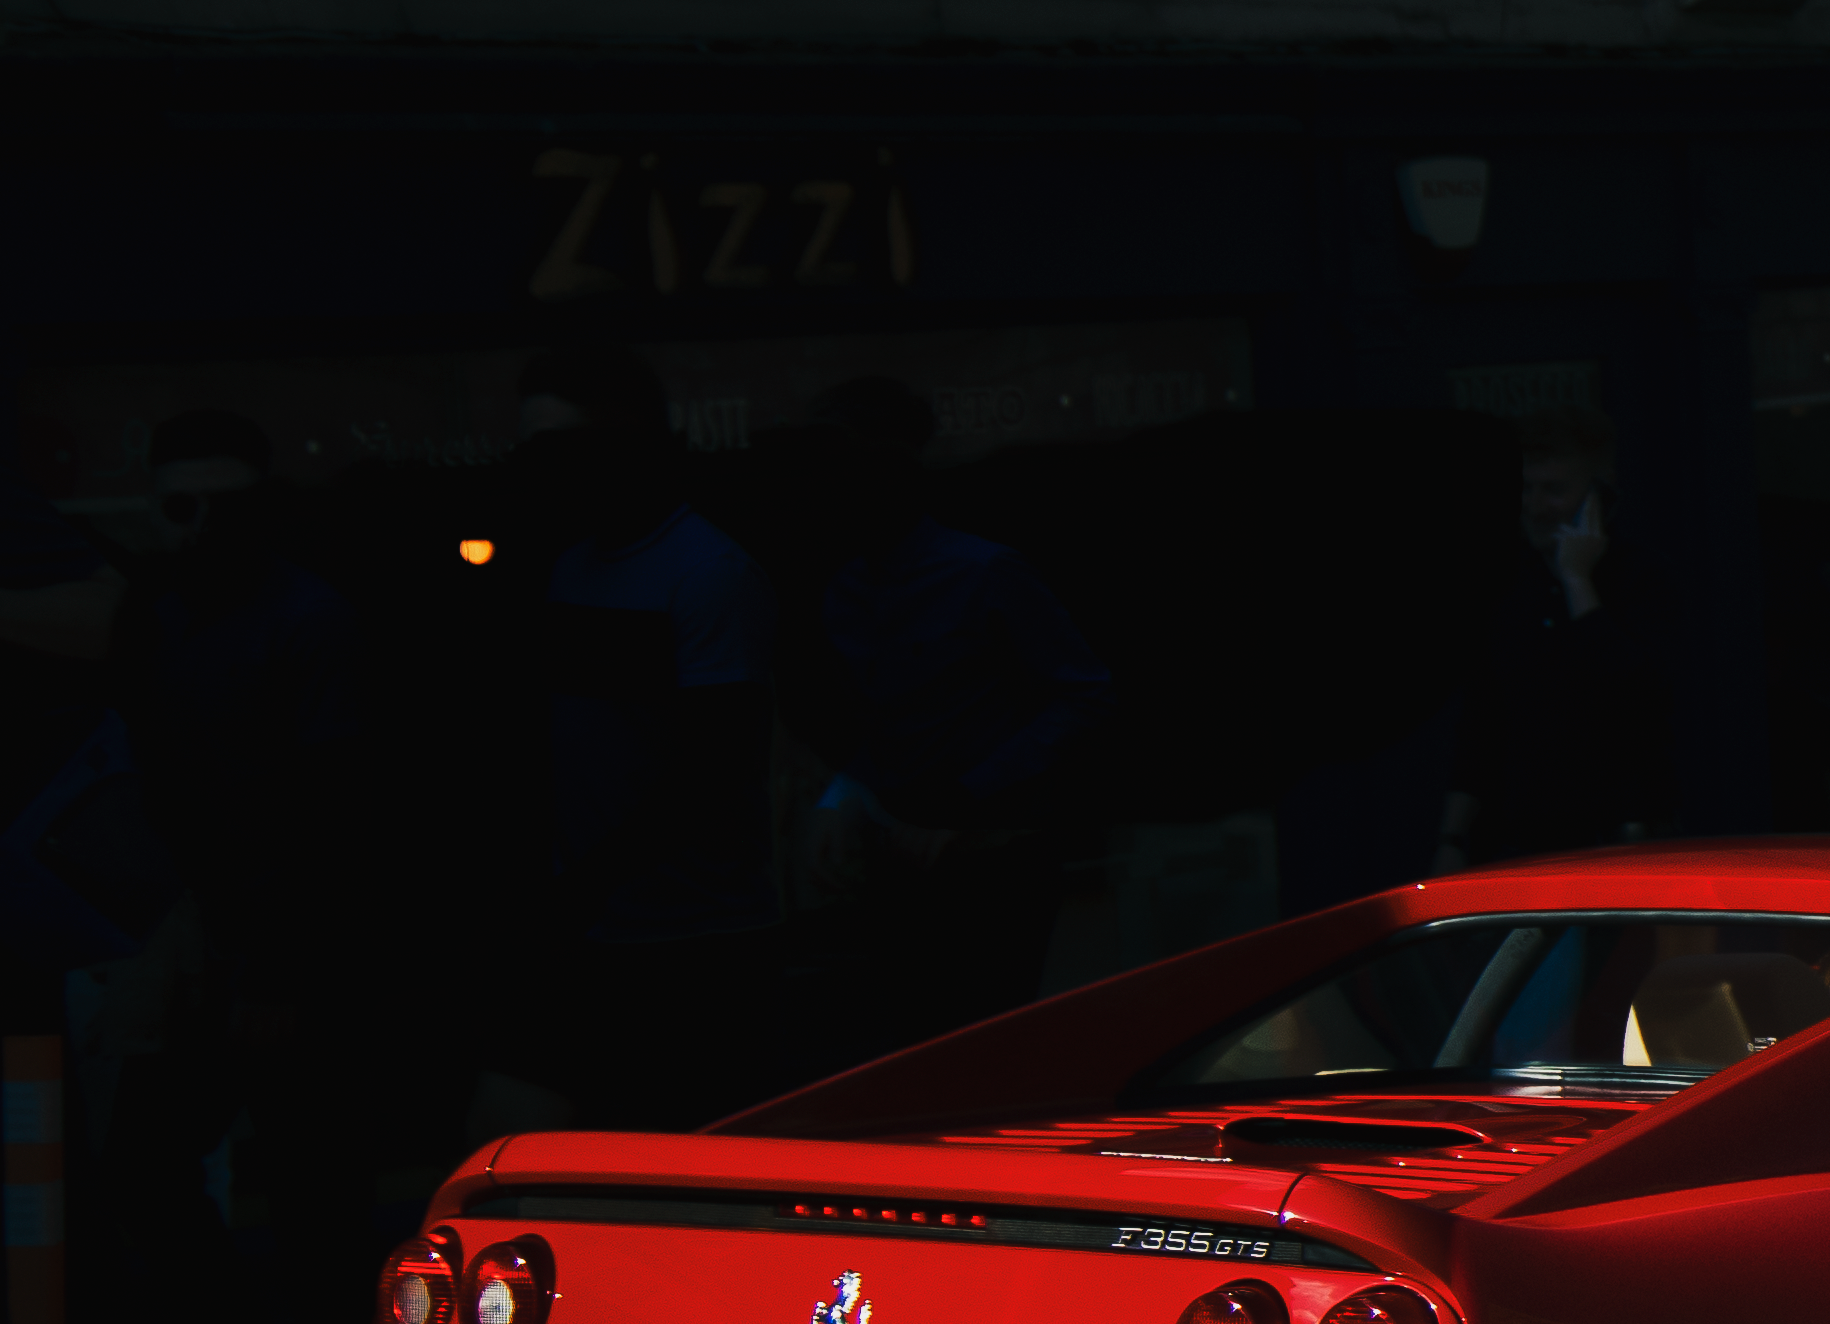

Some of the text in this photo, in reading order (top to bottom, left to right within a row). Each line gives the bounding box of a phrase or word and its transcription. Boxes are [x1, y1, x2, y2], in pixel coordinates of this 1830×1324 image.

[527, 146, 916, 304] Zizzi
[1110, 1226, 1271, 1259] F355 GTS
